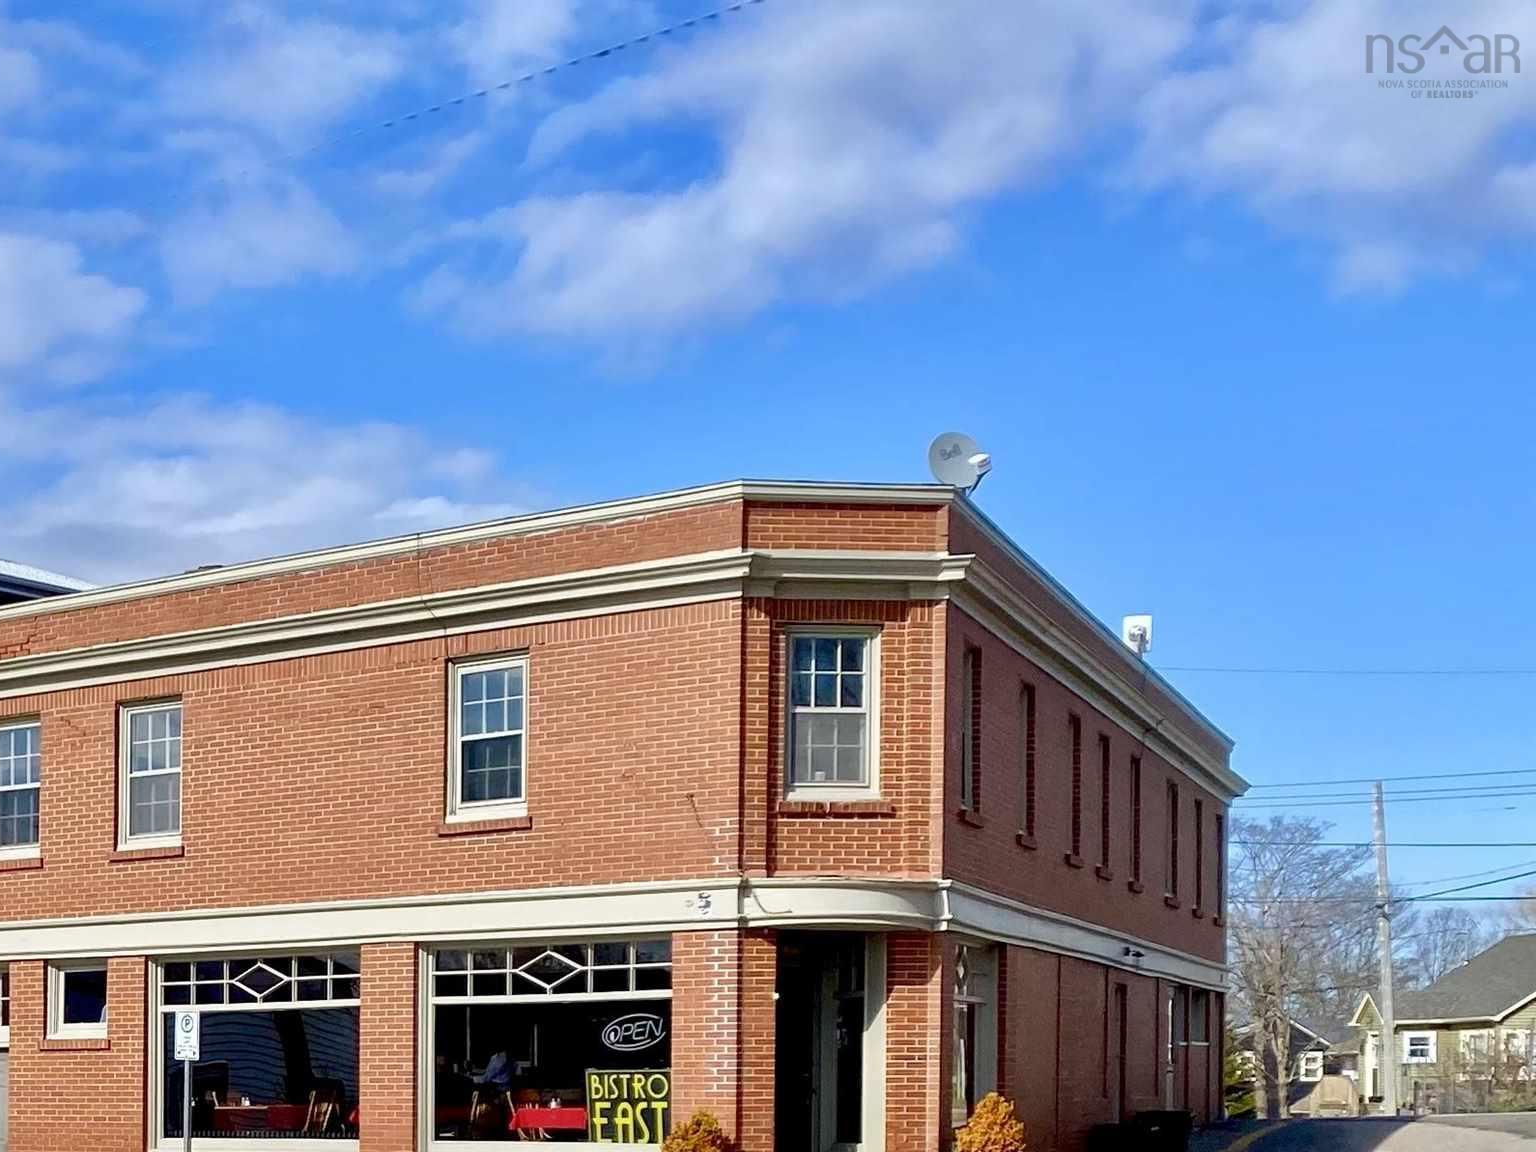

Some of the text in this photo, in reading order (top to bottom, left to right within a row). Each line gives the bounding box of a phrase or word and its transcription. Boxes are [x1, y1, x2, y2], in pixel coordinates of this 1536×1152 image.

[939, 443, 962, 461] Bell
[605, 1019, 664, 1044] OPEN
[591, 1074, 669, 1099] BISTRO
[592, 1102, 668, 1144] EAST
